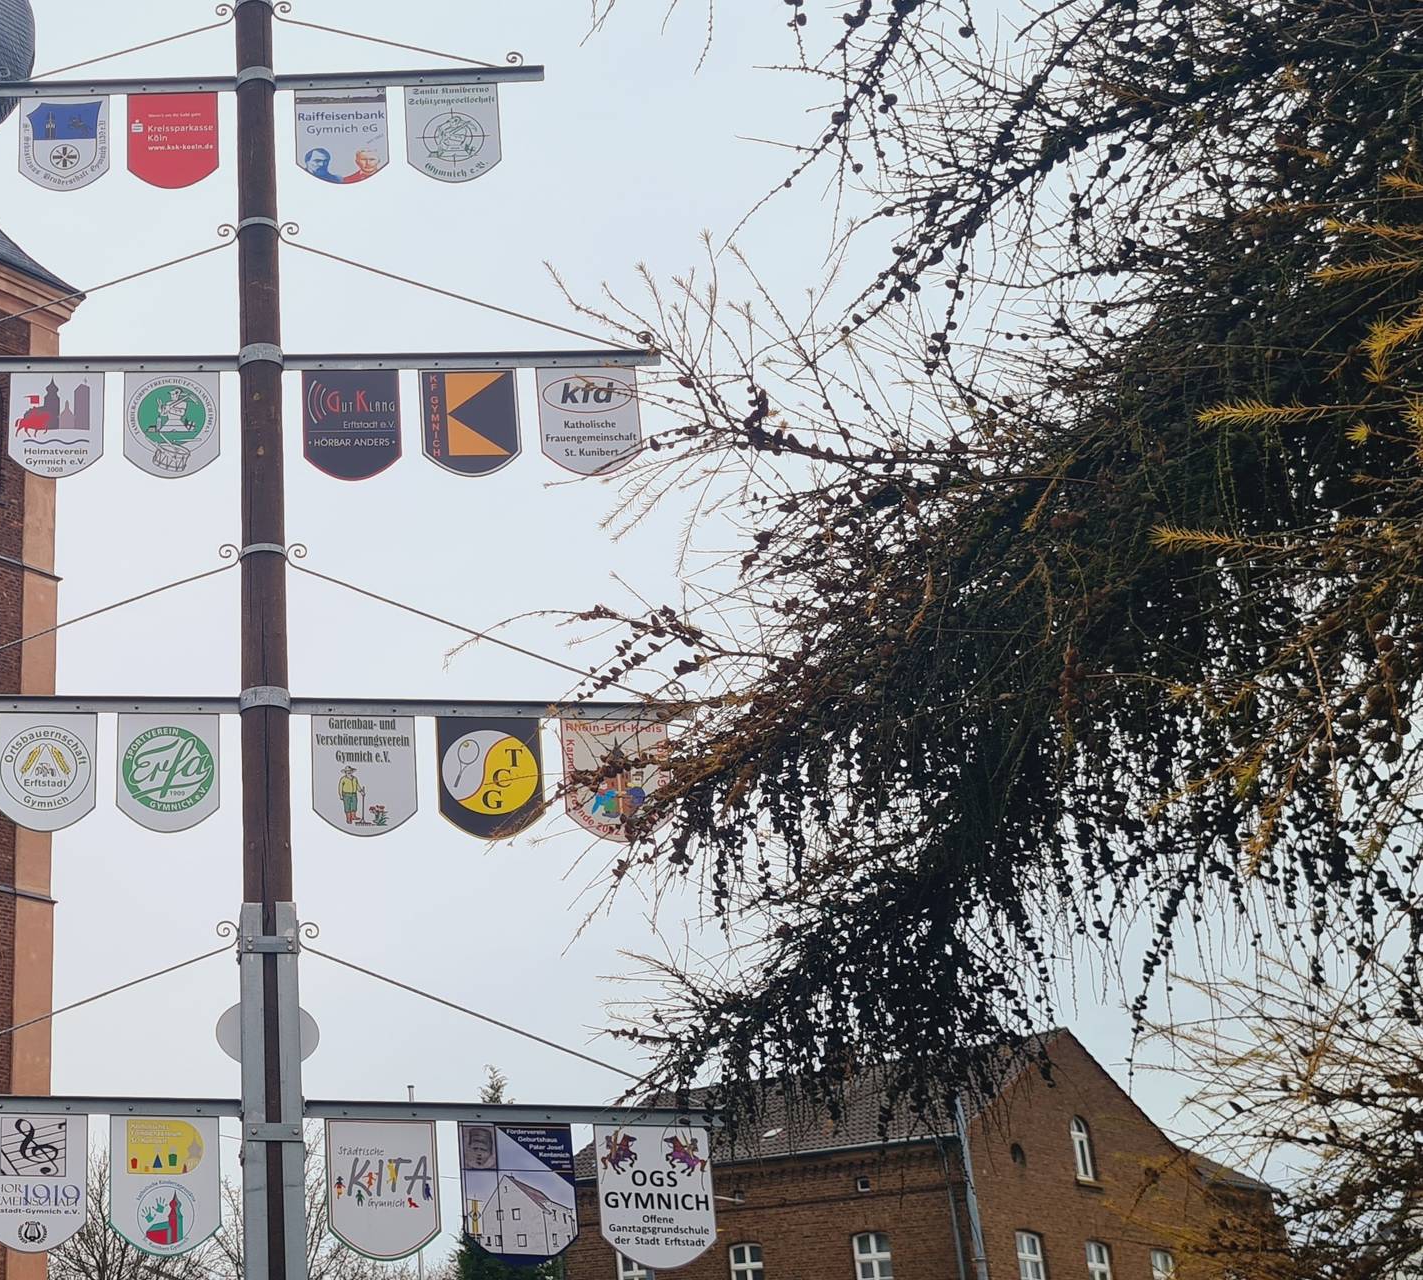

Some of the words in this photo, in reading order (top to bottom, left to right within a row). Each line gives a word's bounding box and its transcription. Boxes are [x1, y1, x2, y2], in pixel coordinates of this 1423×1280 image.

[297, 110, 385, 121] Raiffeisenbank
[148, 124, 214, 133] Kreissparkasse
[306, 123, 358, 136] Gymnich
[362, 124, 378, 132] eG
[148, 134, 168, 142] Köln
[148, 143, 214, 151] www.ksk-koeln.de
[343, 420, 378, 429] Erftstadt
[380, 421, 396, 429] e.V.
[430, 396, 441, 457] GYMNICH
[564, 420, 617, 429] Katholische
[353, 438, 390, 447] ANDERS
[545, 432, 637, 444] Frauengemeinschaft
[24, 447, 88, 455] Heimatverein
[565, 448, 577, 457] St.
[579, 447, 619, 457] Kunibert
[25, 457, 67, 467] Gymnich
[69, 457, 86, 465] e.V.
[328, 717, 377, 731] Gartenbau-
[379, 718, 396, 730] und
[126, 727, 179, 761] SPORTVEREIN
[315, 733, 410, 747] Verschönerungsverein
[4, 730, 87, 765] Ortsbauernschaft
[335, 750, 373, 764] Gymnich
[375, 751, 391, 763] e.V.
[129, 737, 212, 799] Erfa
[23, 779, 67, 788] Erftstadt
[23, 795, 69, 808] Gymnich
[149, 798, 194, 811] GYMNICH
[337, 1146, 385, 1156] Städtische
[347, 1155, 432, 1200] KITA
[631, 1170, 678, 1188] OGS
[23, 1184, 81, 1206] 1919
[604, 1191, 710, 1211] GYMNICH
[367, 1199, 405, 1209] Gymnich
[642, 1215, 674, 1224] Offene
[609, 1223, 710, 1235] Ganztagsgrundschule
[614, 1236, 631, 1245] der
[635, 1236, 661, 1246] Stadt
[664, 1237, 706, 1247] Erftstadt
